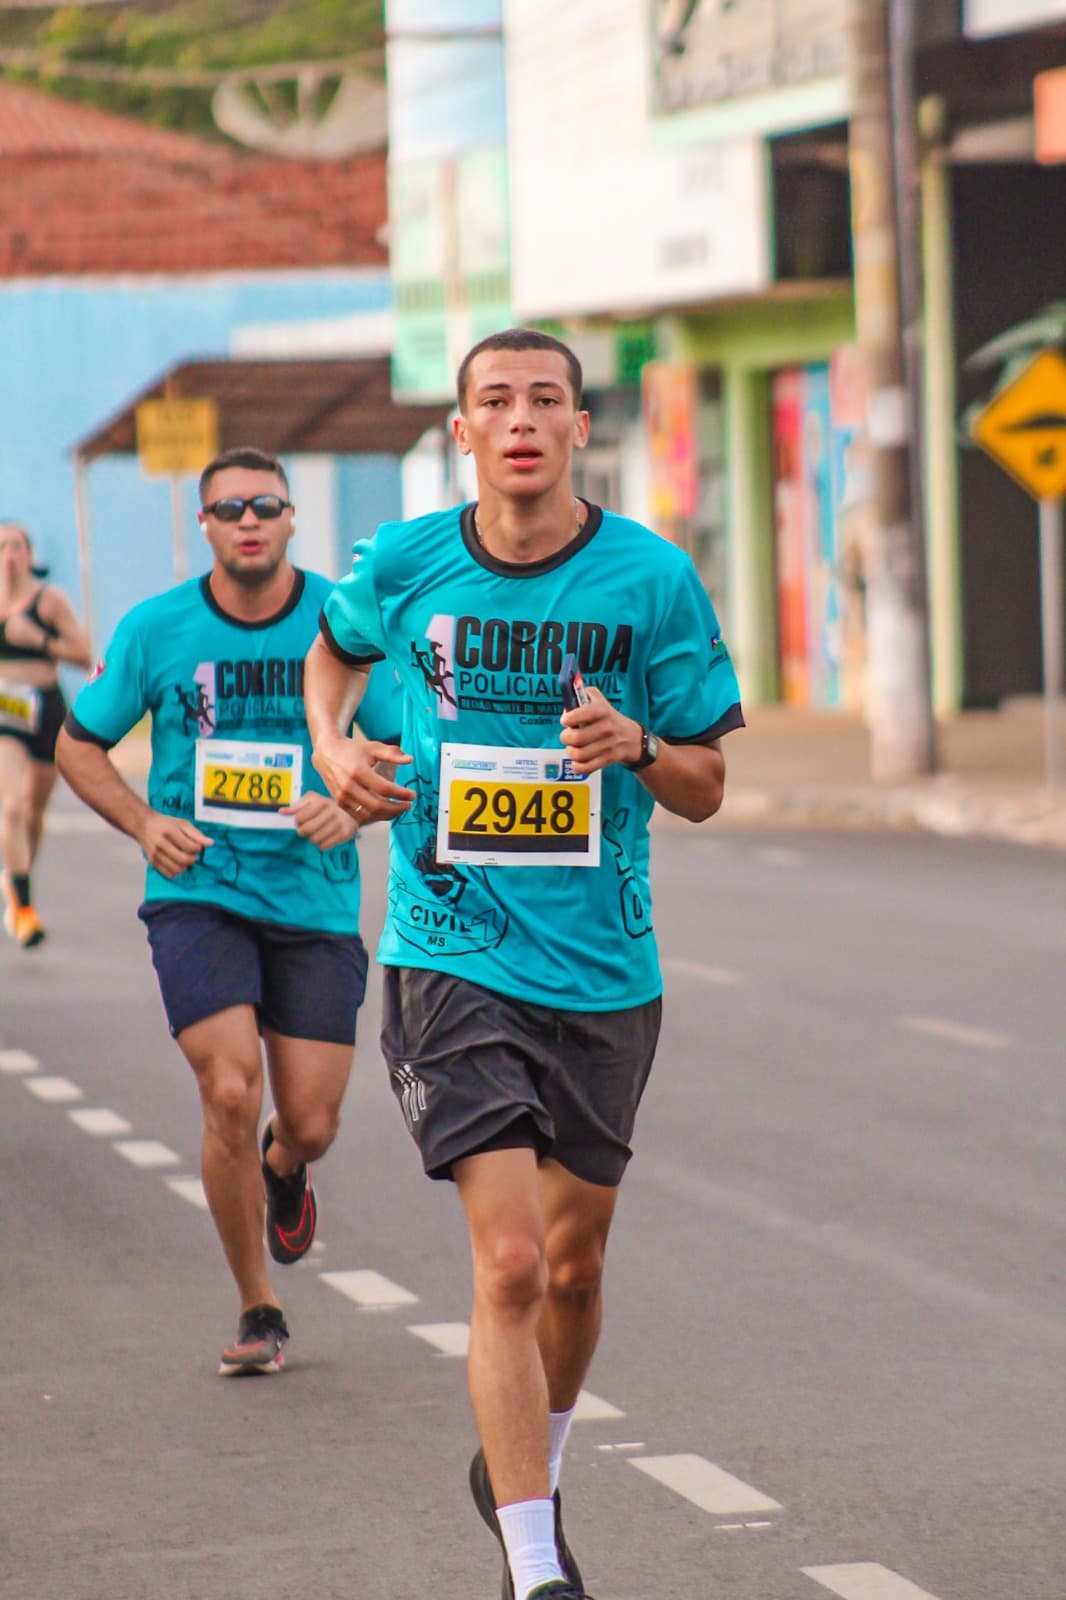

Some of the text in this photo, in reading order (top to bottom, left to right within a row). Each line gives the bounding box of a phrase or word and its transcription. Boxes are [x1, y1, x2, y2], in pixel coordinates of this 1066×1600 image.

[455, 616, 633, 674] CORRIDA
[217, 658, 306, 698] CORRI
[459, 671, 561, 697] POLICIAL
[211, 770, 283, 802] 2786
[462, 786, 575, 834] 2948
[409, 904, 474, 933] CIVIL
[426, 935, 446, 948] MS
